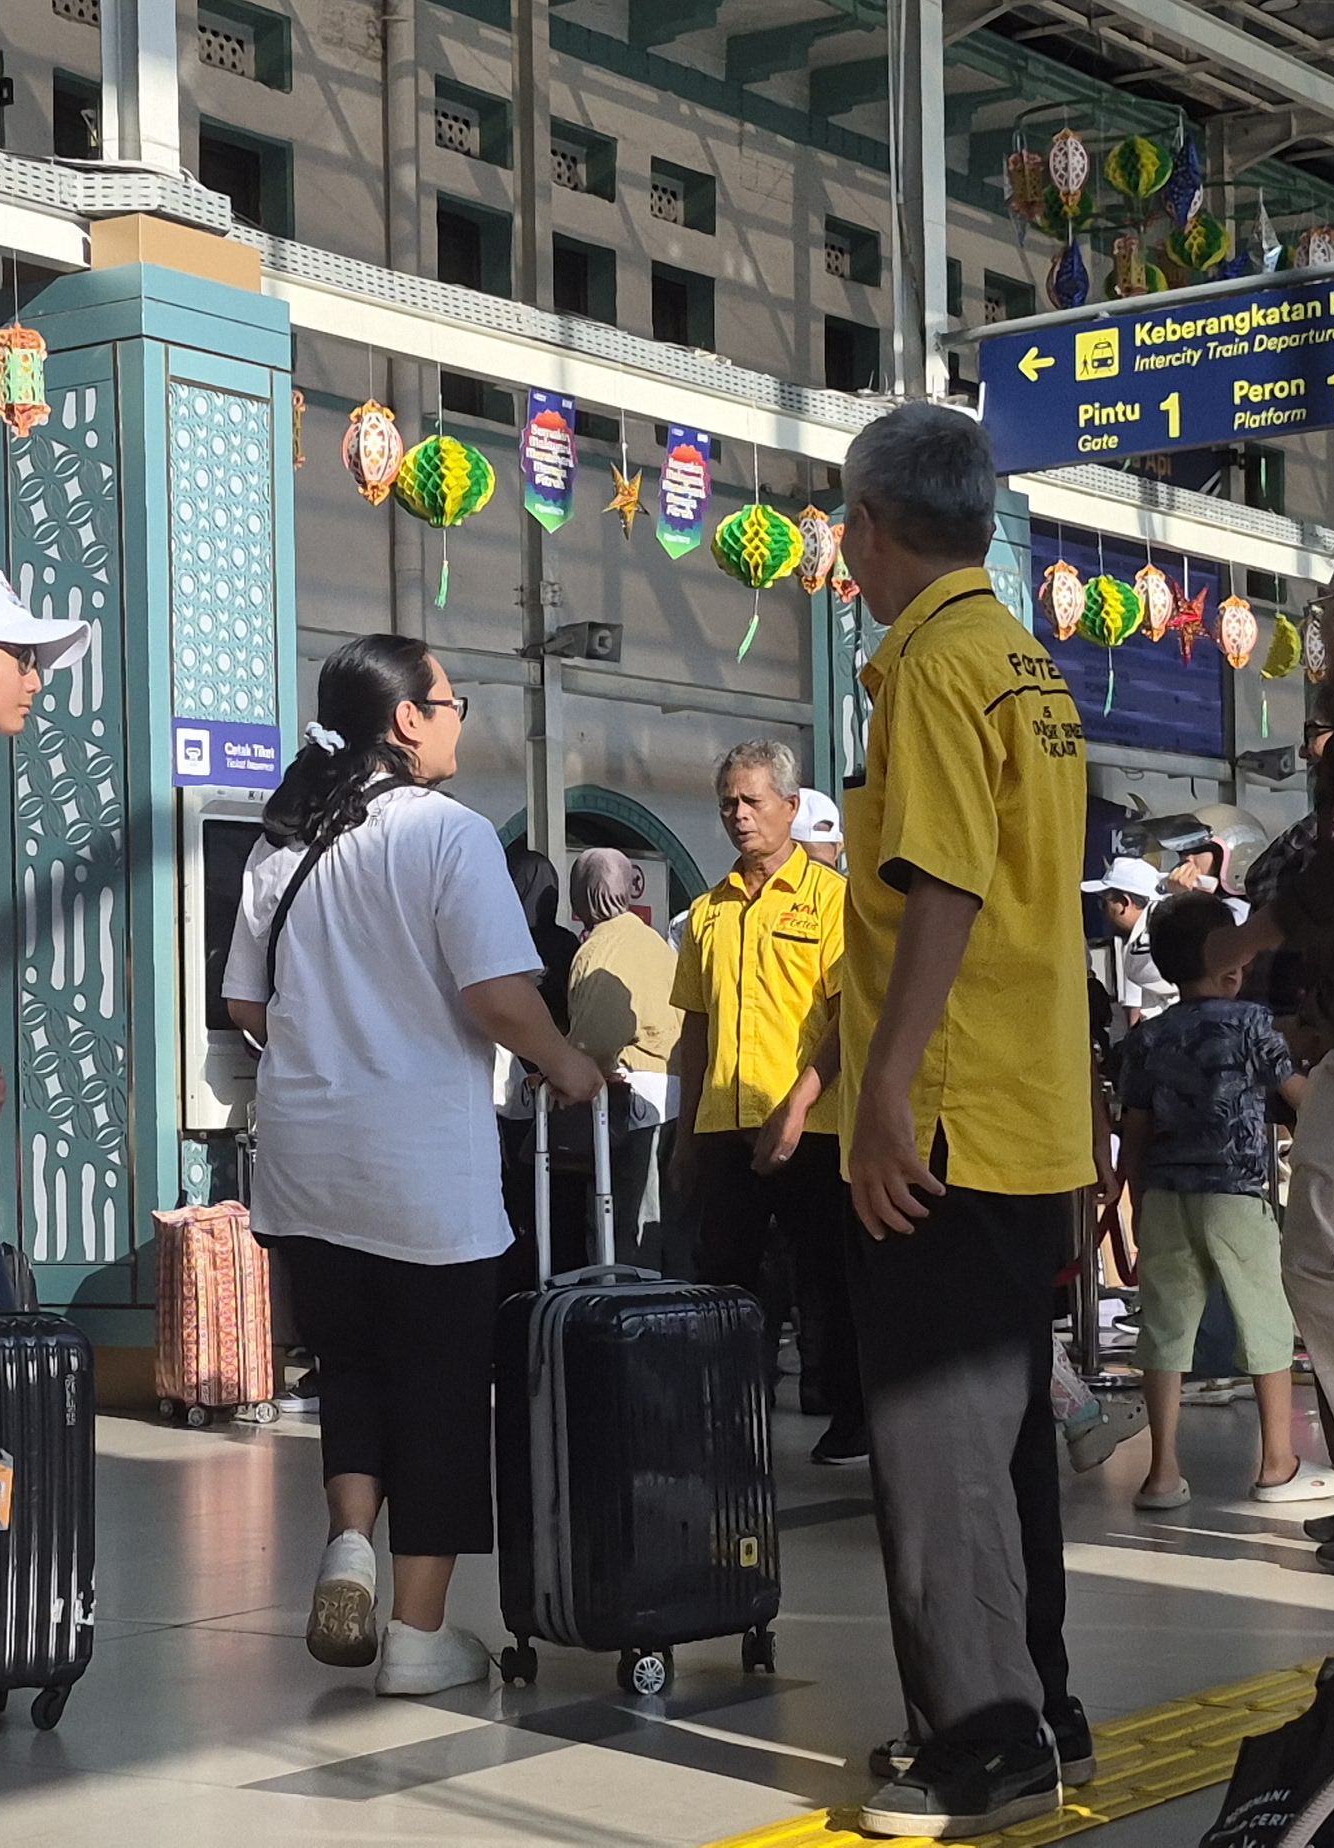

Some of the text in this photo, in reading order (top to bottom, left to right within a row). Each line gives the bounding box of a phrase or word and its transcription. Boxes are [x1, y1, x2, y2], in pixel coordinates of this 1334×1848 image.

[1134, 303, 1322, 348] Keberangkatan
[1133, 347, 1203, 373] Intercity
[1206, 337, 1249, 361] Train
[1078, 401, 1141, 428] Pintu
[1160, 392, 1181, 438] 1
[1233, 377, 1306, 405] Peron
[1078, 406, 1307, 453] Gate Platform
[1249, 1812, 1295, 1828] CERI
